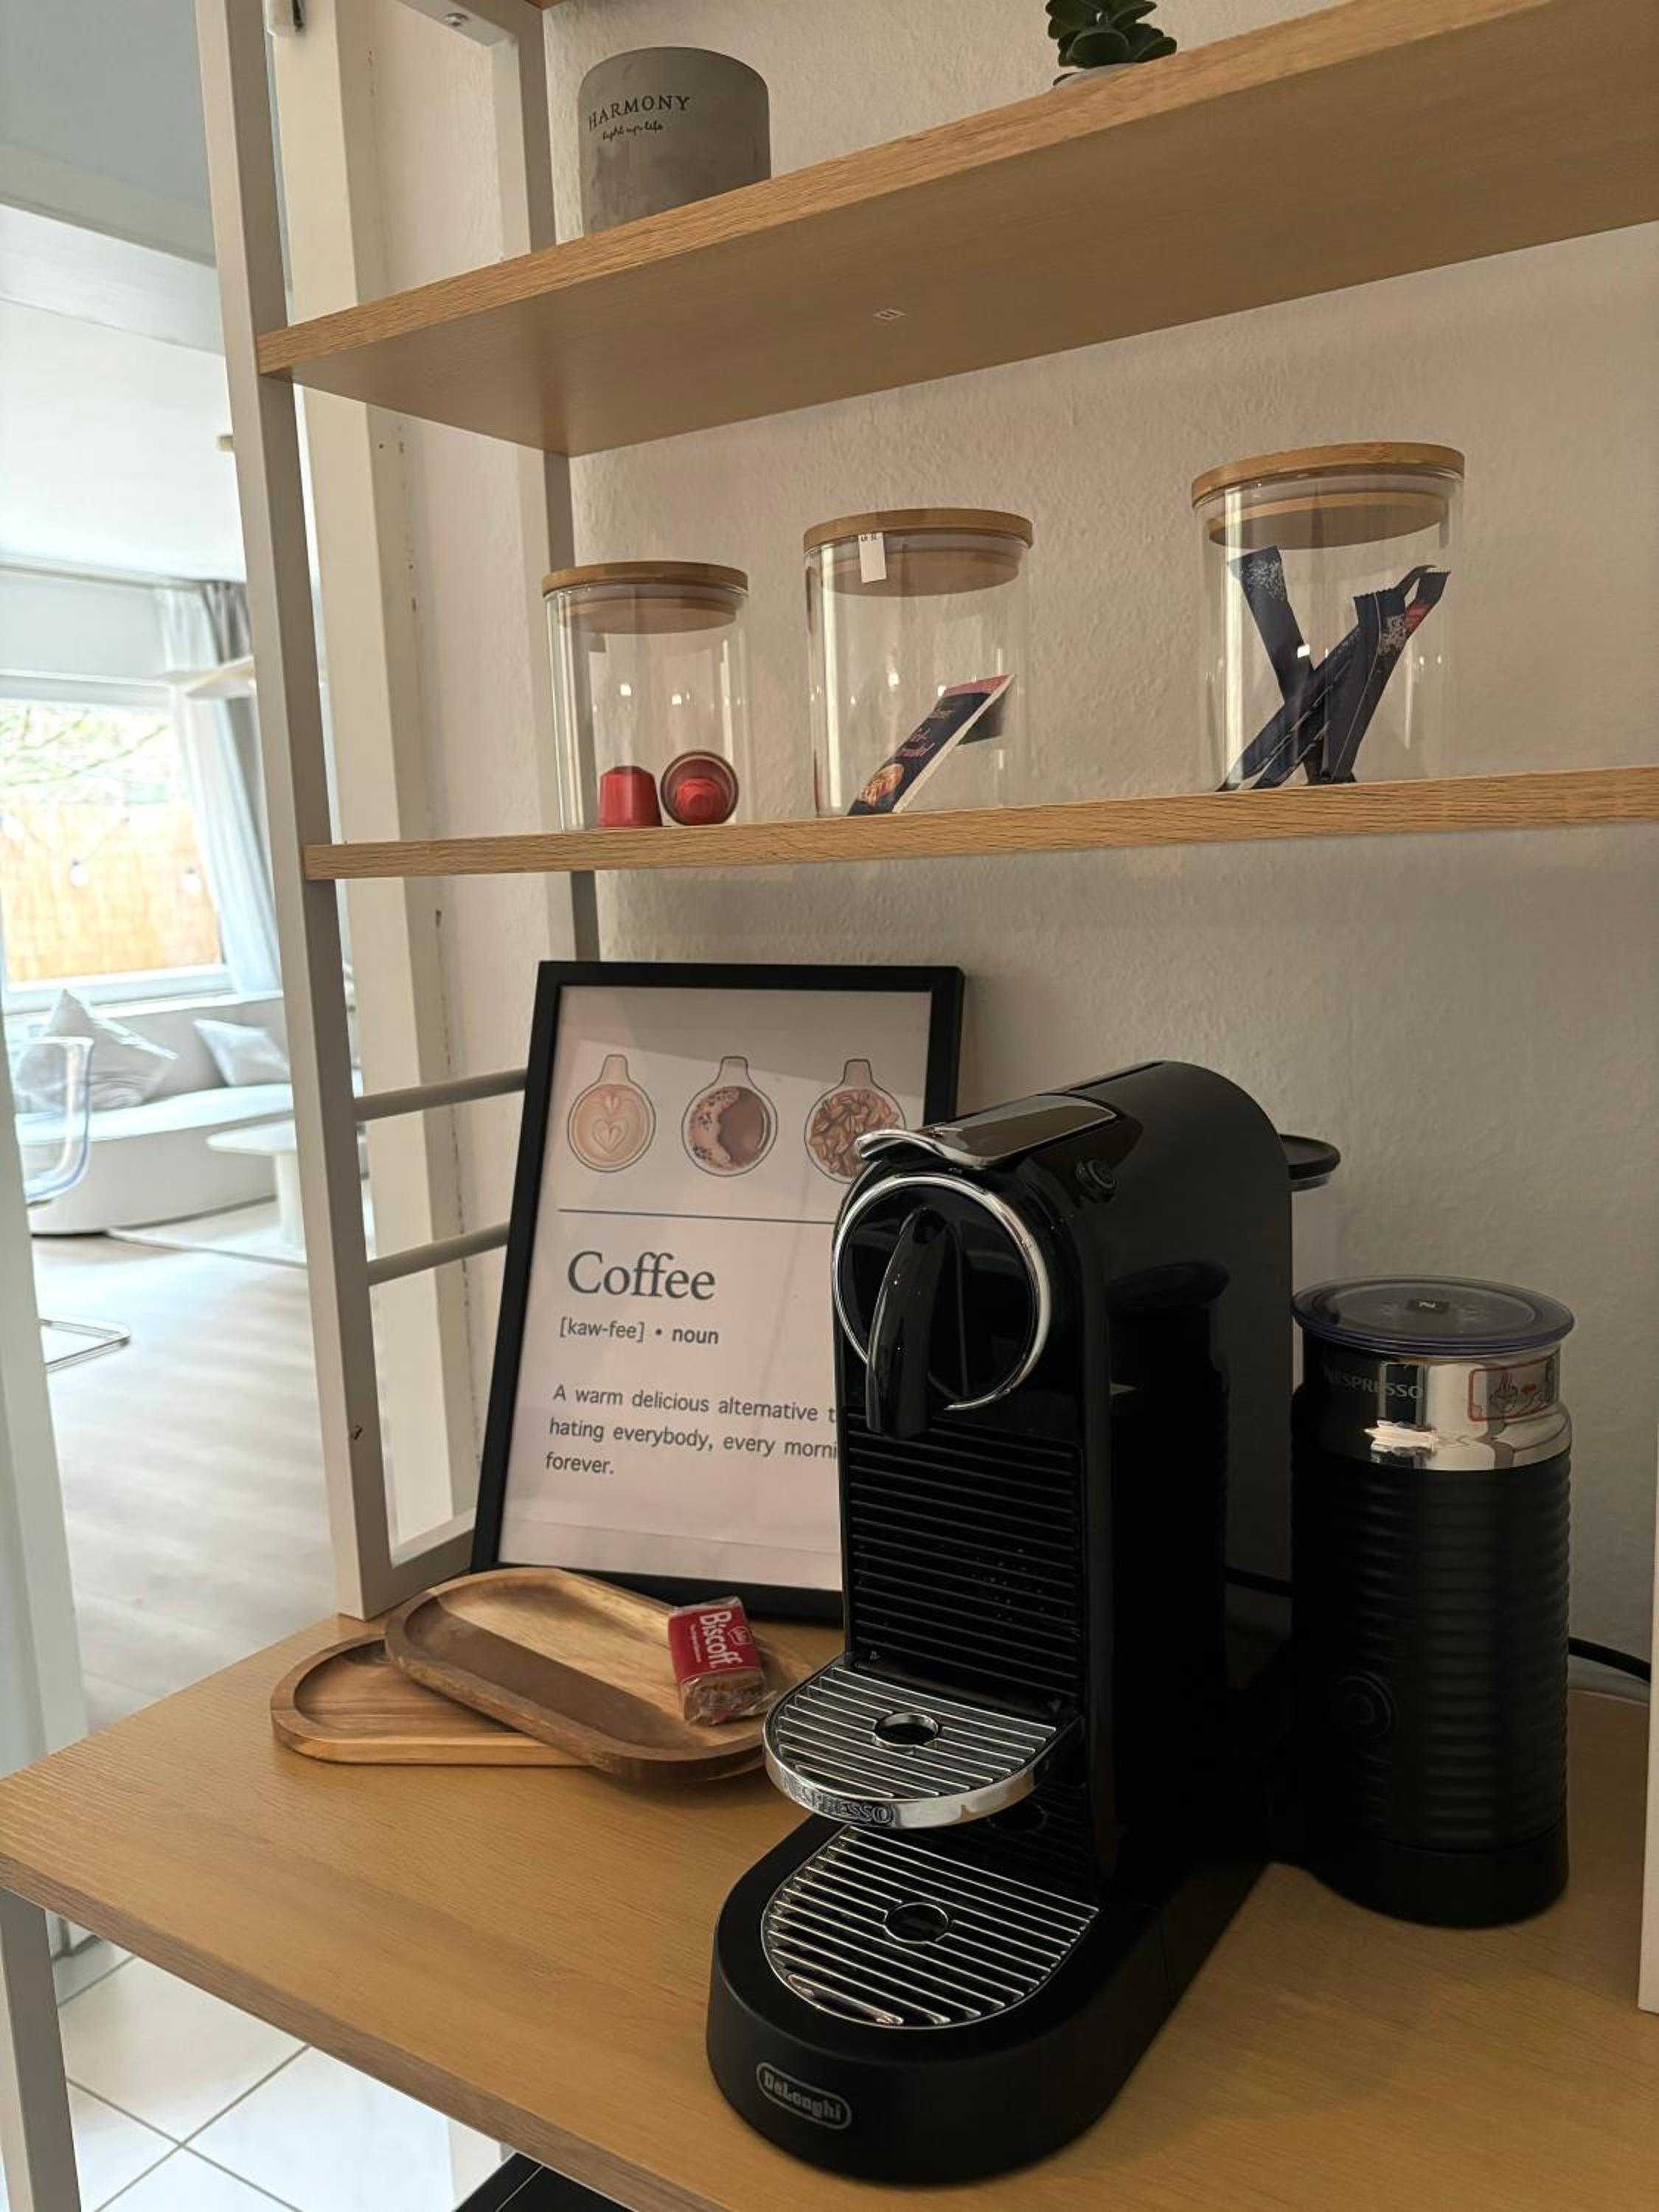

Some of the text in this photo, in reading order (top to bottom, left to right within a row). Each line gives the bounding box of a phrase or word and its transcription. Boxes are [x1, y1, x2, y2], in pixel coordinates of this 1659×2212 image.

[588, 94, 690, 130] HARMONY
[567, 1251, 716, 1301] Coffee
[560, 1316, 720, 1345] [kaw-fee] noun
[553, 1384, 836, 1424] A warm delicious alternative t
[549, 1417, 836, 1460] hating everybody, every morni
[546, 1452, 614, 1475] forever.
[699, 1611, 744, 1667] Biscoff
